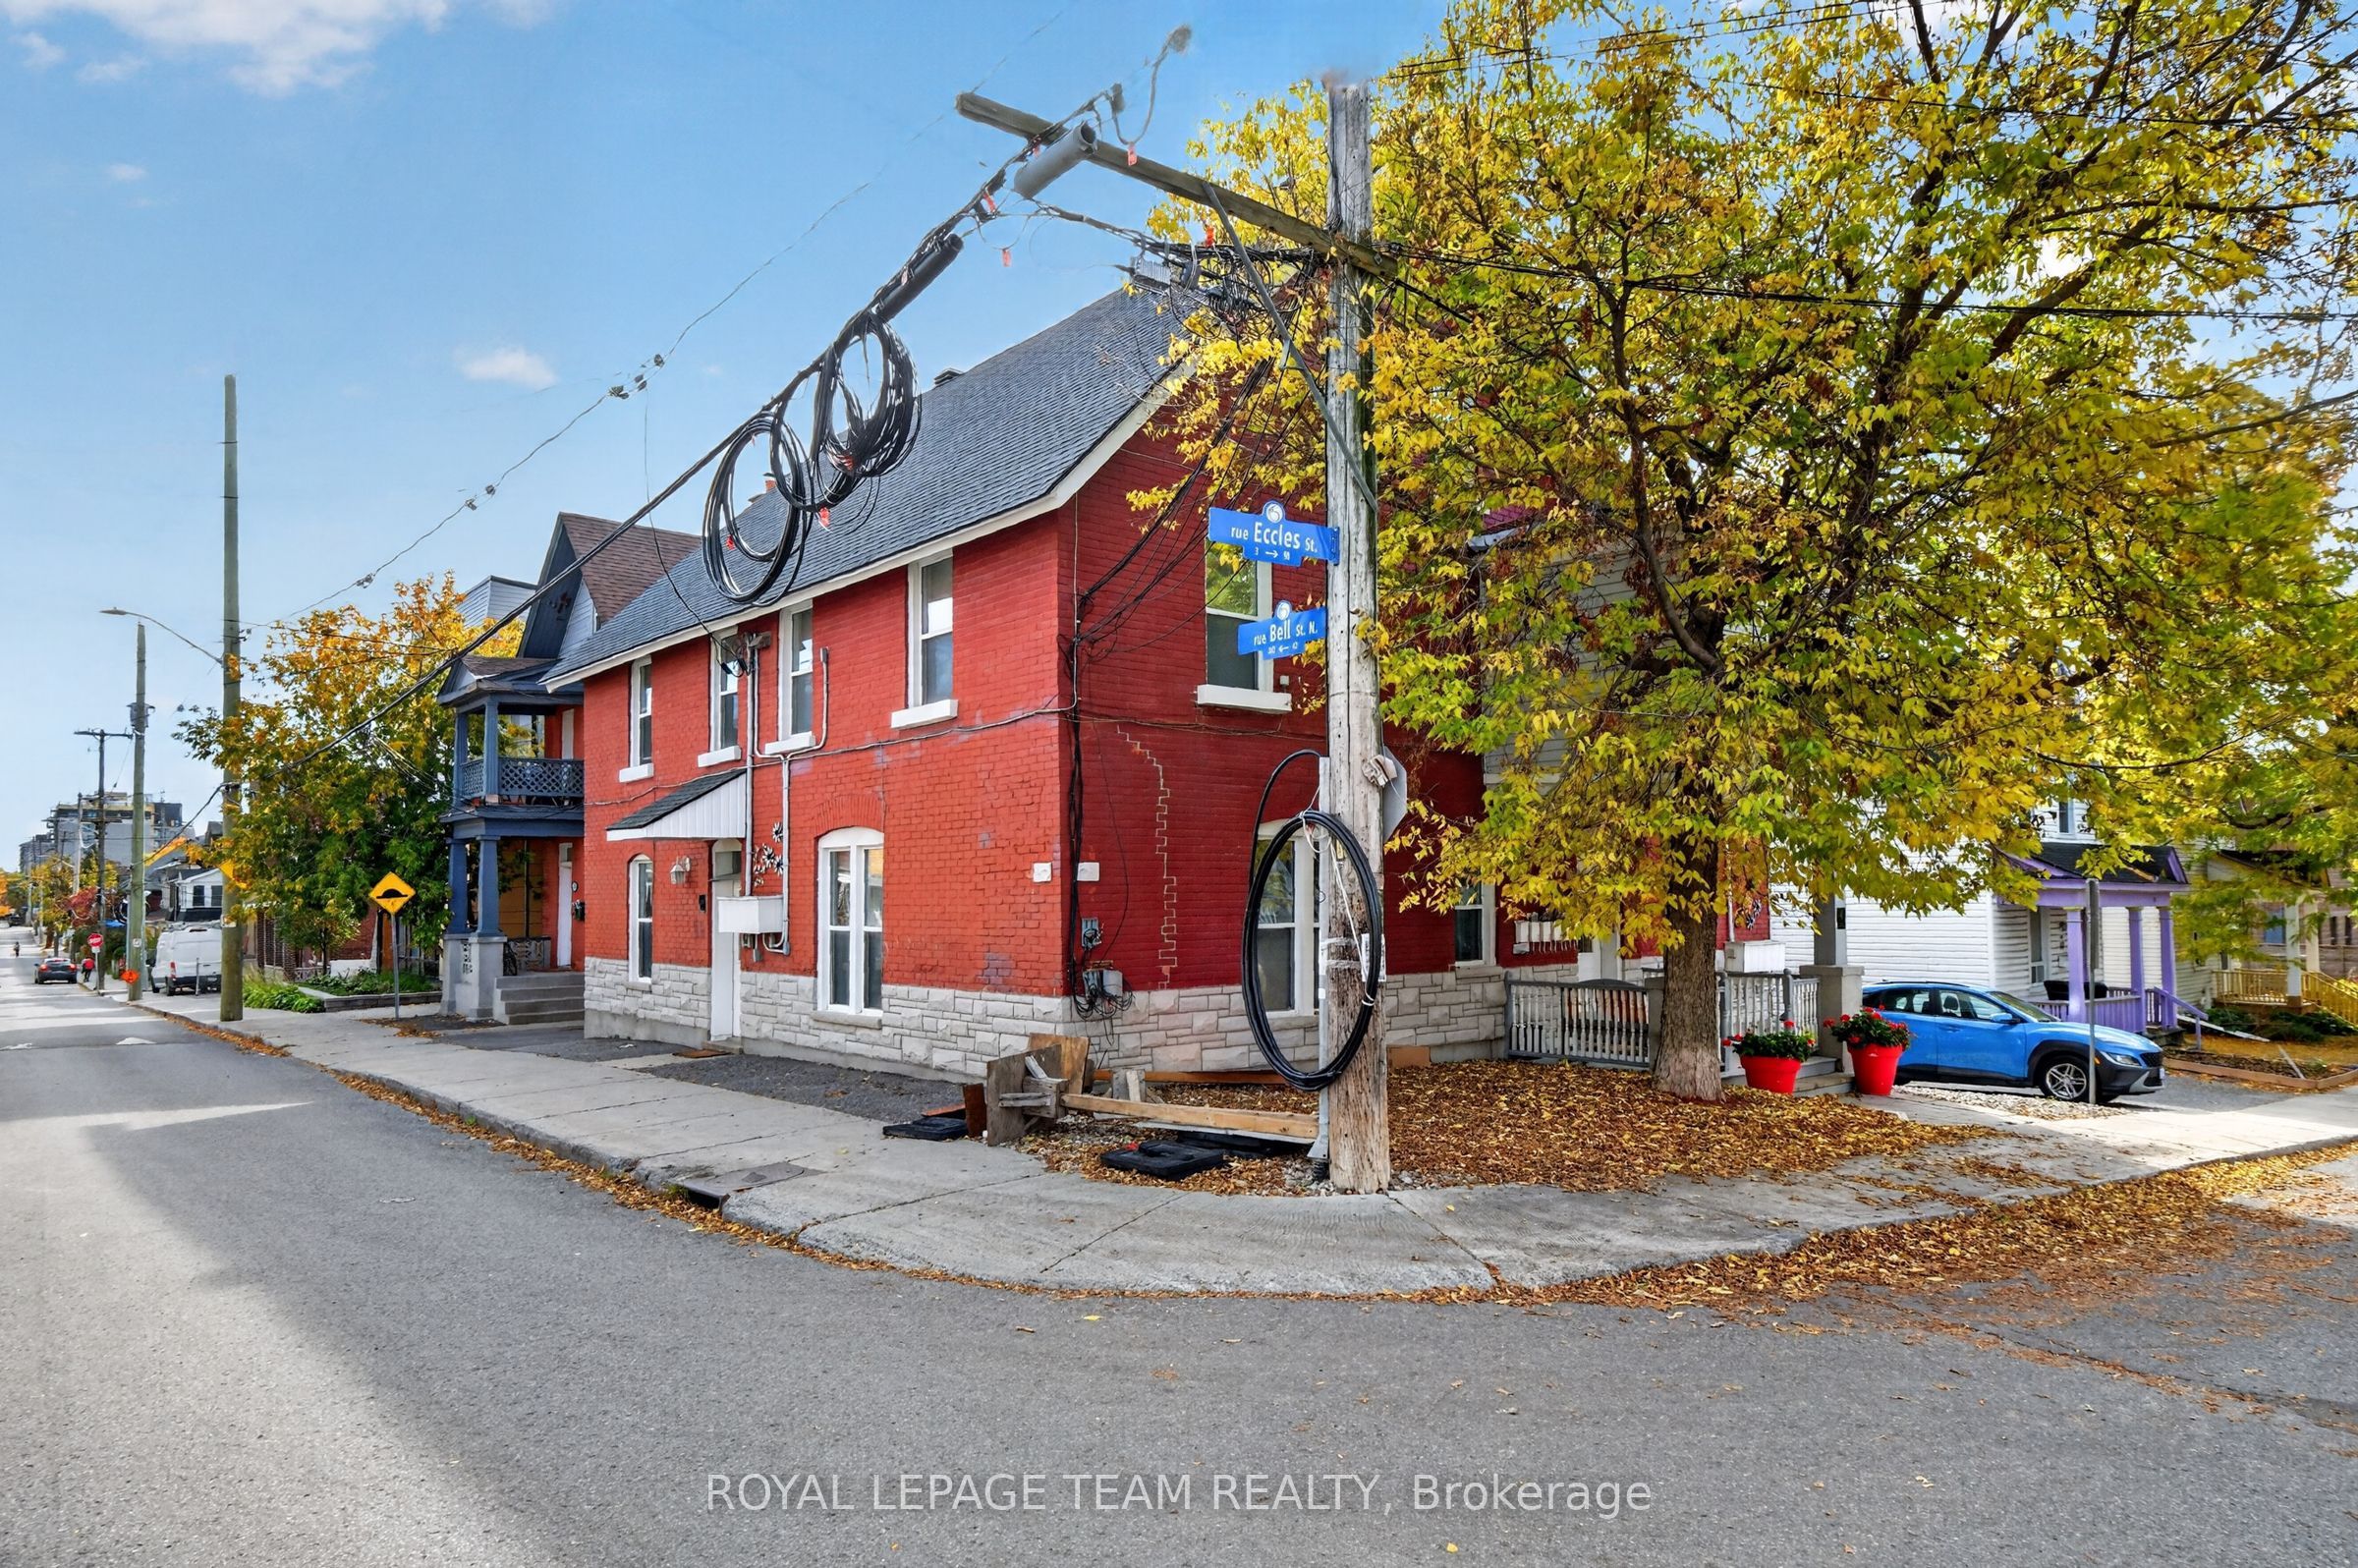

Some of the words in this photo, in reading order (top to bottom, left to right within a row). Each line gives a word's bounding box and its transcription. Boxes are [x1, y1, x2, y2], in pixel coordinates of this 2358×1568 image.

[1230, 526, 1250, 540] rue
[1254, 522, 1301, 550] Eccles
[1305, 537, 1319, 553] St.
[1254, 634, 1266, 646] rue
[1269, 619, 1291, 643] Bell
[1296, 624, 1306, 637] St.
[1309, 621, 1319, 635] N.
